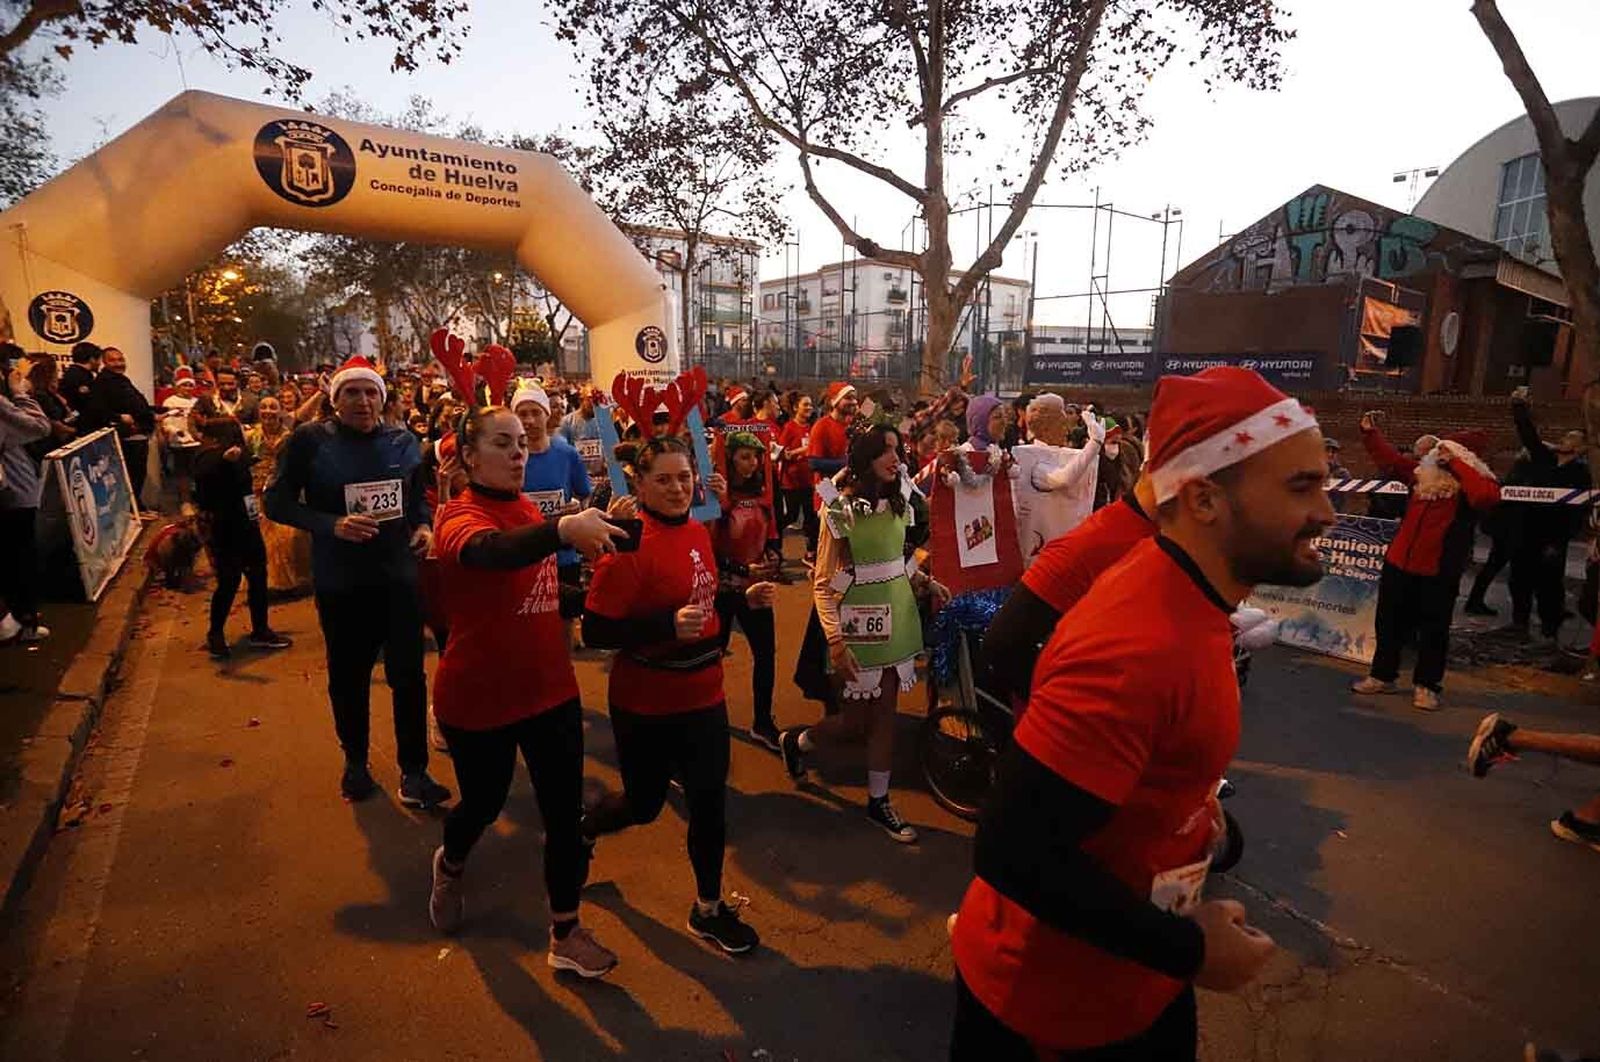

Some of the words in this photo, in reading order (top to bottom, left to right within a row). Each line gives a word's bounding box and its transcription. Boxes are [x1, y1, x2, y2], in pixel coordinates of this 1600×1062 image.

[360, 139, 517, 174] Ayuntamiento
[409, 164, 436, 181] de
[445, 169, 519, 193] Huelva
[446, 190, 461, 200] de
[466, 192, 521, 208] Deportes
[1048, 361, 1082, 370] HYUNDAI
[1106, 361, 1145, 370] HYUNDAI
[1261, 360, 1312, 369] HYUNDAI
[371, 492, 398, 510] 233
[1504, 489, 1530, 499] POLICIA
[1533, 490, 1555, 500] LOCAL
[541, 500, 560, 513] 234
[1331, 550, 1384, 570] Huelv
[1345, 568, 1381, 581] Depor
[866, 617, 883, 632] 66
